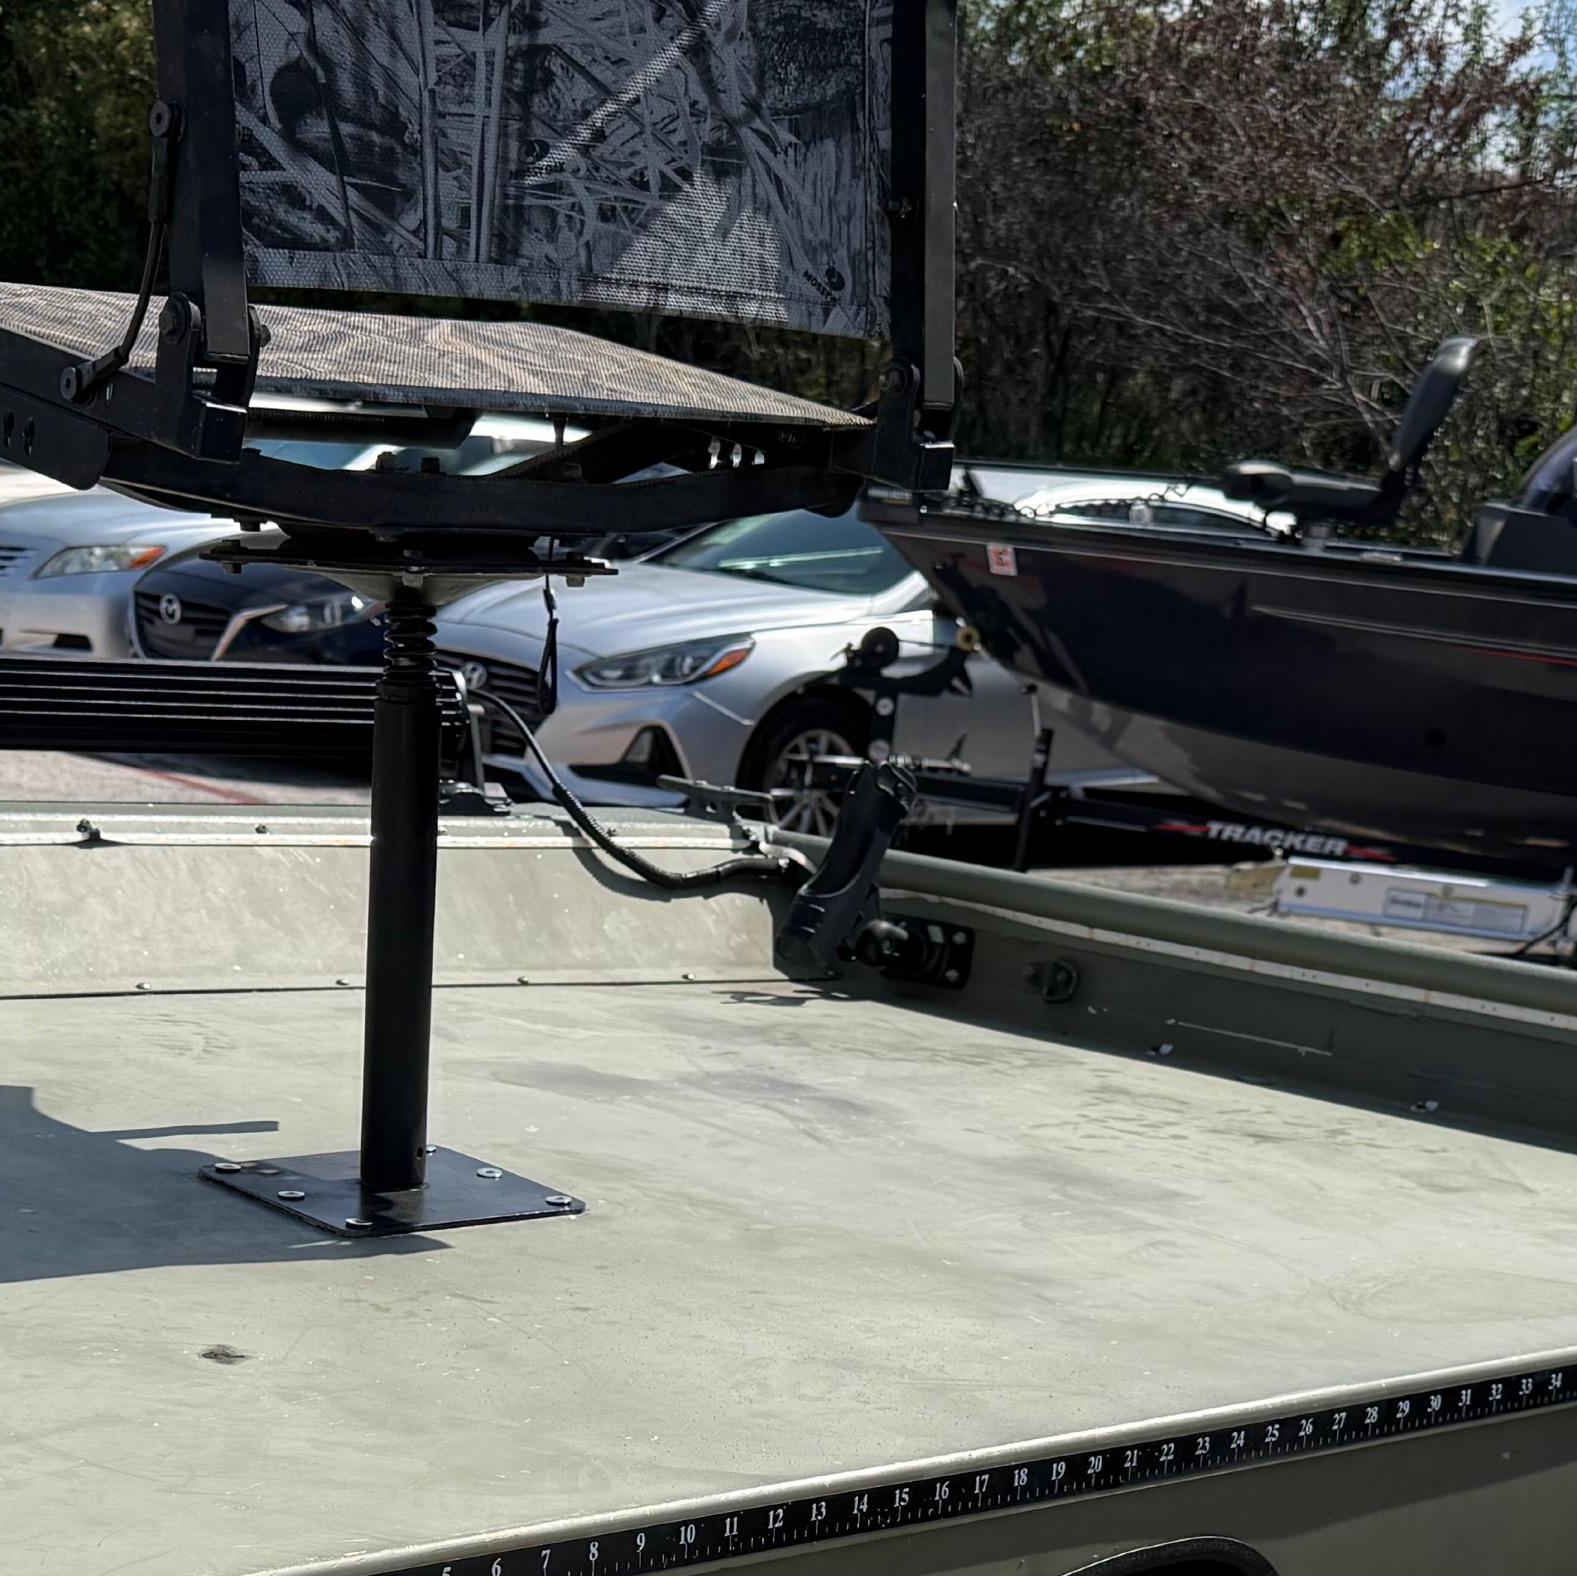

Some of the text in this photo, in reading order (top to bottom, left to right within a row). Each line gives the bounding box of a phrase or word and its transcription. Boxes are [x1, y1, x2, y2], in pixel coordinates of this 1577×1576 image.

[1206, 821, 1348, 856] TRACKER
[541, 1550, 550, 1568] 7
[589, 1542, 598, 1560] 8
[636, 1533, 646, 1552] 9
[679, 1524, 696, 1545] 10
[724, 1517, 738, 1536] 11
[768, 1509, 783, 1528] 12
[810, 1501, 827, 1521] 13
[853, 1494, 868, 1514] 14
[894, 1488, 910, 1507] 15
[934, 1481, 950, 1500] 16
[974, 1474, 989, 1493] 17
[1013, 1468, 1028, 1487] 18
[1051, 1461, 1066, 1480] 19
[1087, 1455, 1102, 1474] 20
[1124, 1450, 1138, 1468] 21
[1159, 1443, 1175, 1462] 22
[1195, 1437, 1210, 1455] 23
[1230, 1430, 1245, 1449] 24
[1265, 1424, 1280, 1442] 25
[1298, 1418, 1314, 1436] 26
[1332, 1412, 1347, 1430] 27
[1365, 1406, 1379, 1424] 28
[1396, 1400, 1410, 1418] 29
[1427, 1394, 1441, 1412] 30
[1458, 1389, 1471, 1406] 31
[1489, 1384, 1503, 1400] 32
[1519, 1378, 1533, 1395] 33
[1548, 1372, 1562, 1389] 34
